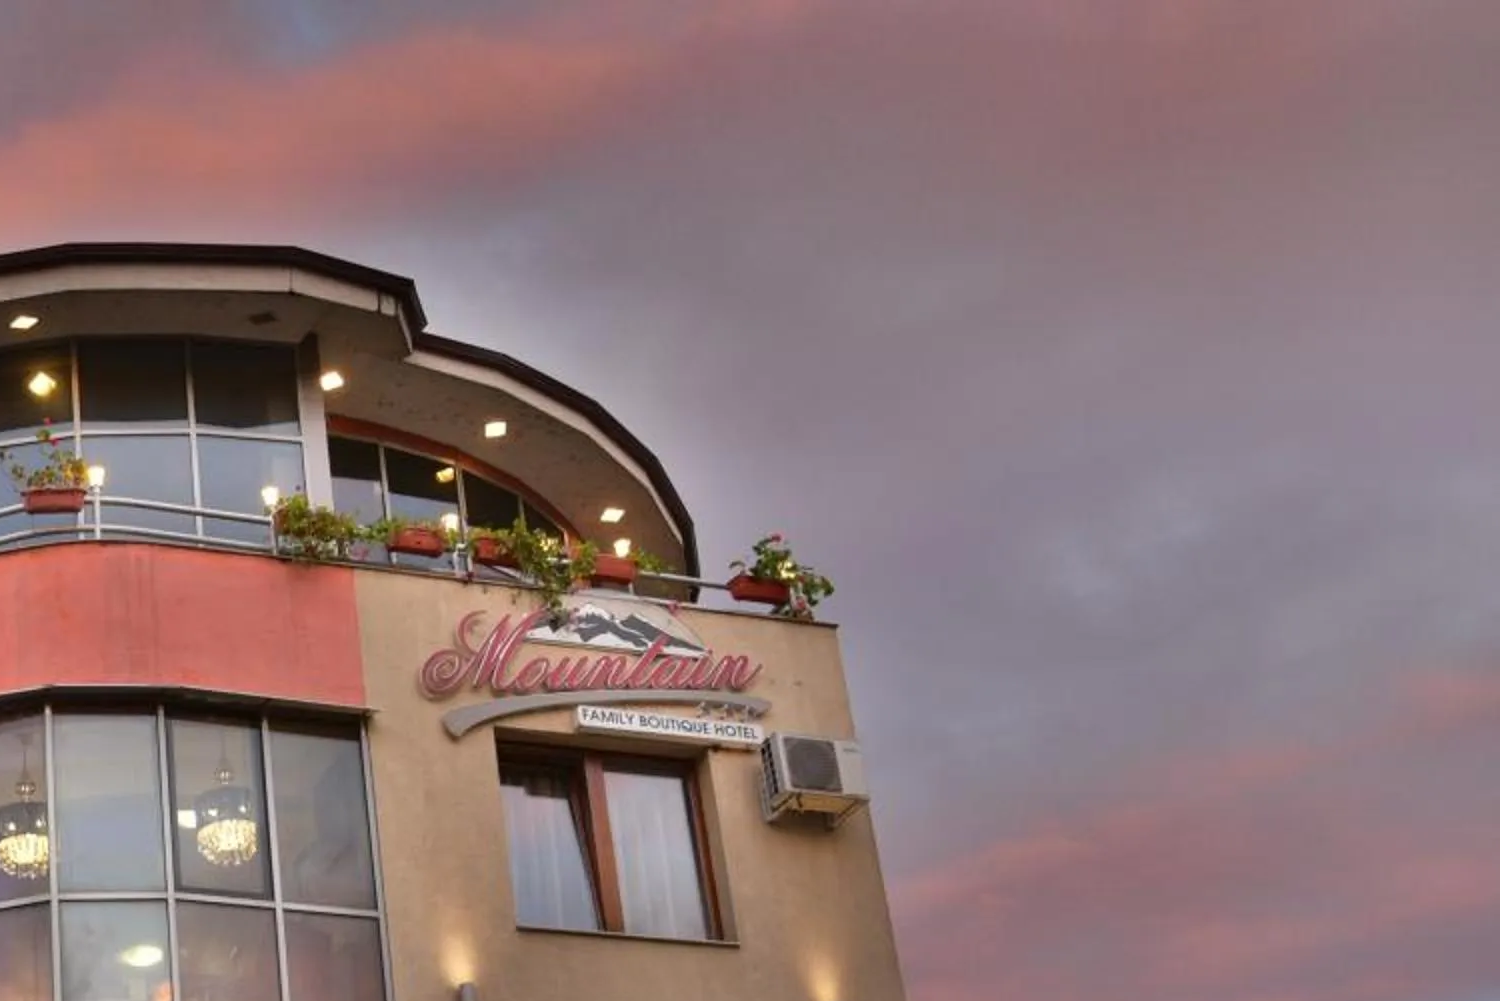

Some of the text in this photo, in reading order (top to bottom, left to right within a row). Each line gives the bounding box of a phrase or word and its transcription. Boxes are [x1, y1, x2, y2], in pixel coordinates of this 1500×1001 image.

[419, 606, 762, 697] Mountain
[581, 707, 759, 740] FAMILY BOUTIQUE HOTEL
